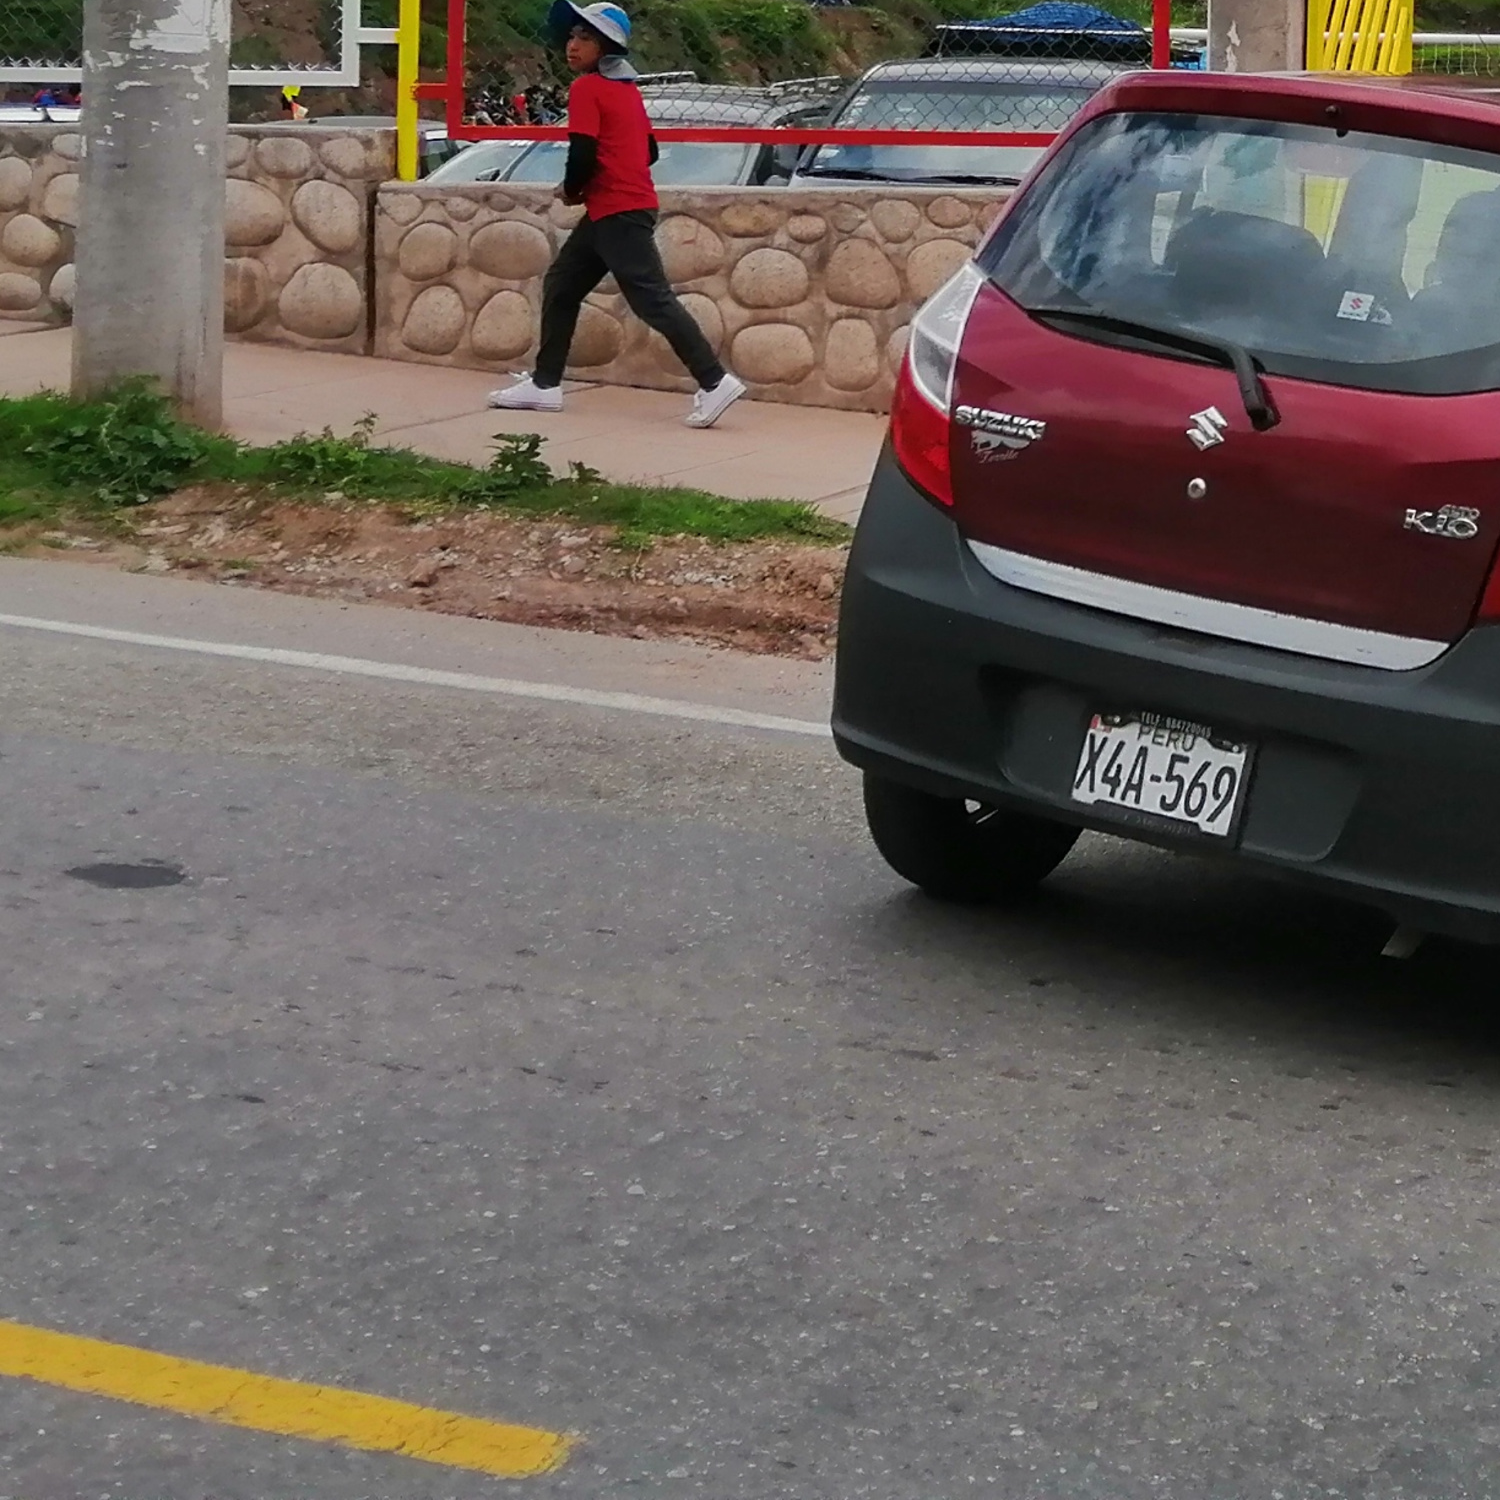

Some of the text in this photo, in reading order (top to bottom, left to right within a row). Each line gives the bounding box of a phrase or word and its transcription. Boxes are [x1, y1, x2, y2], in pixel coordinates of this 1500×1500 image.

[955, 405, 1047, 441] SUZUKI
[1403, 508, 1478, 539] K10
[1137, 725, 1196, 752] PERU
[1074, 732, 1238, 823] X4A-569
